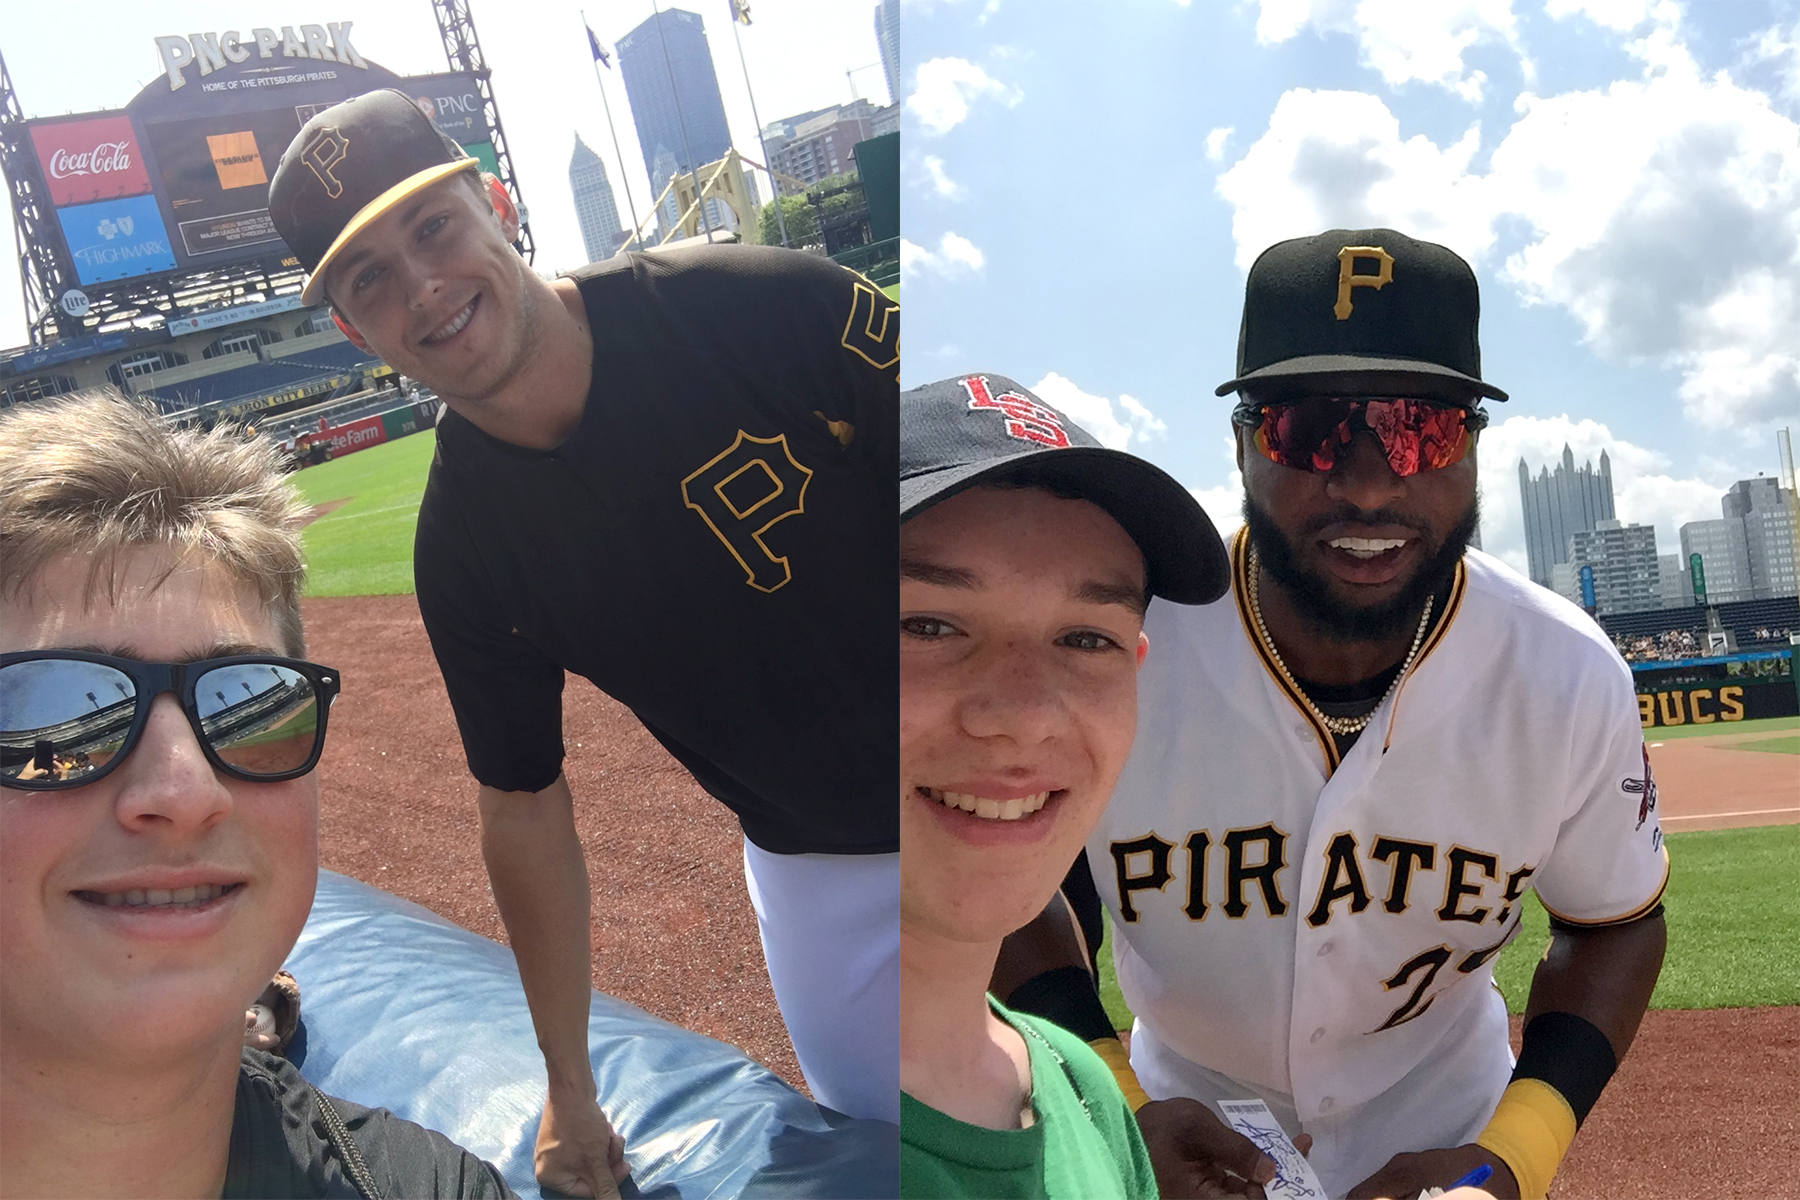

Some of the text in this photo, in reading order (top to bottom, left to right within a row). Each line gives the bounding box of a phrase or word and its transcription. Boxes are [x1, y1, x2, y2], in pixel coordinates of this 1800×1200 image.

[154, 21, 369, 91] PNC PARK
[202, 71, 337, 92] HOME OF THE PITTSBURGH PIRATES
[434, 93, 477, 115] PNC
[50, 141, 131, 179] Coca-Cola
[301, 126, 349, 199] P
[200, 230, 221, 239] MAJOR
[221, 228, 240, 236] LEAGUE
[240, 223, 268, 232] CONTRACT
[226, 233, 240, 241] NOW
[240, 229, 266, 238] THROUGH
[75, 240, 168, 266] HIGHMARK
[281, 256, 300, 267] WEL
[1333, 246, 1395, 320] P
[64, 295, 87, 311] Lite
[239, 381, 333, 412] IRON CITY BEER
[681, 429, 813, 593] P
[1635, 685, 1744, 729] BUCS
